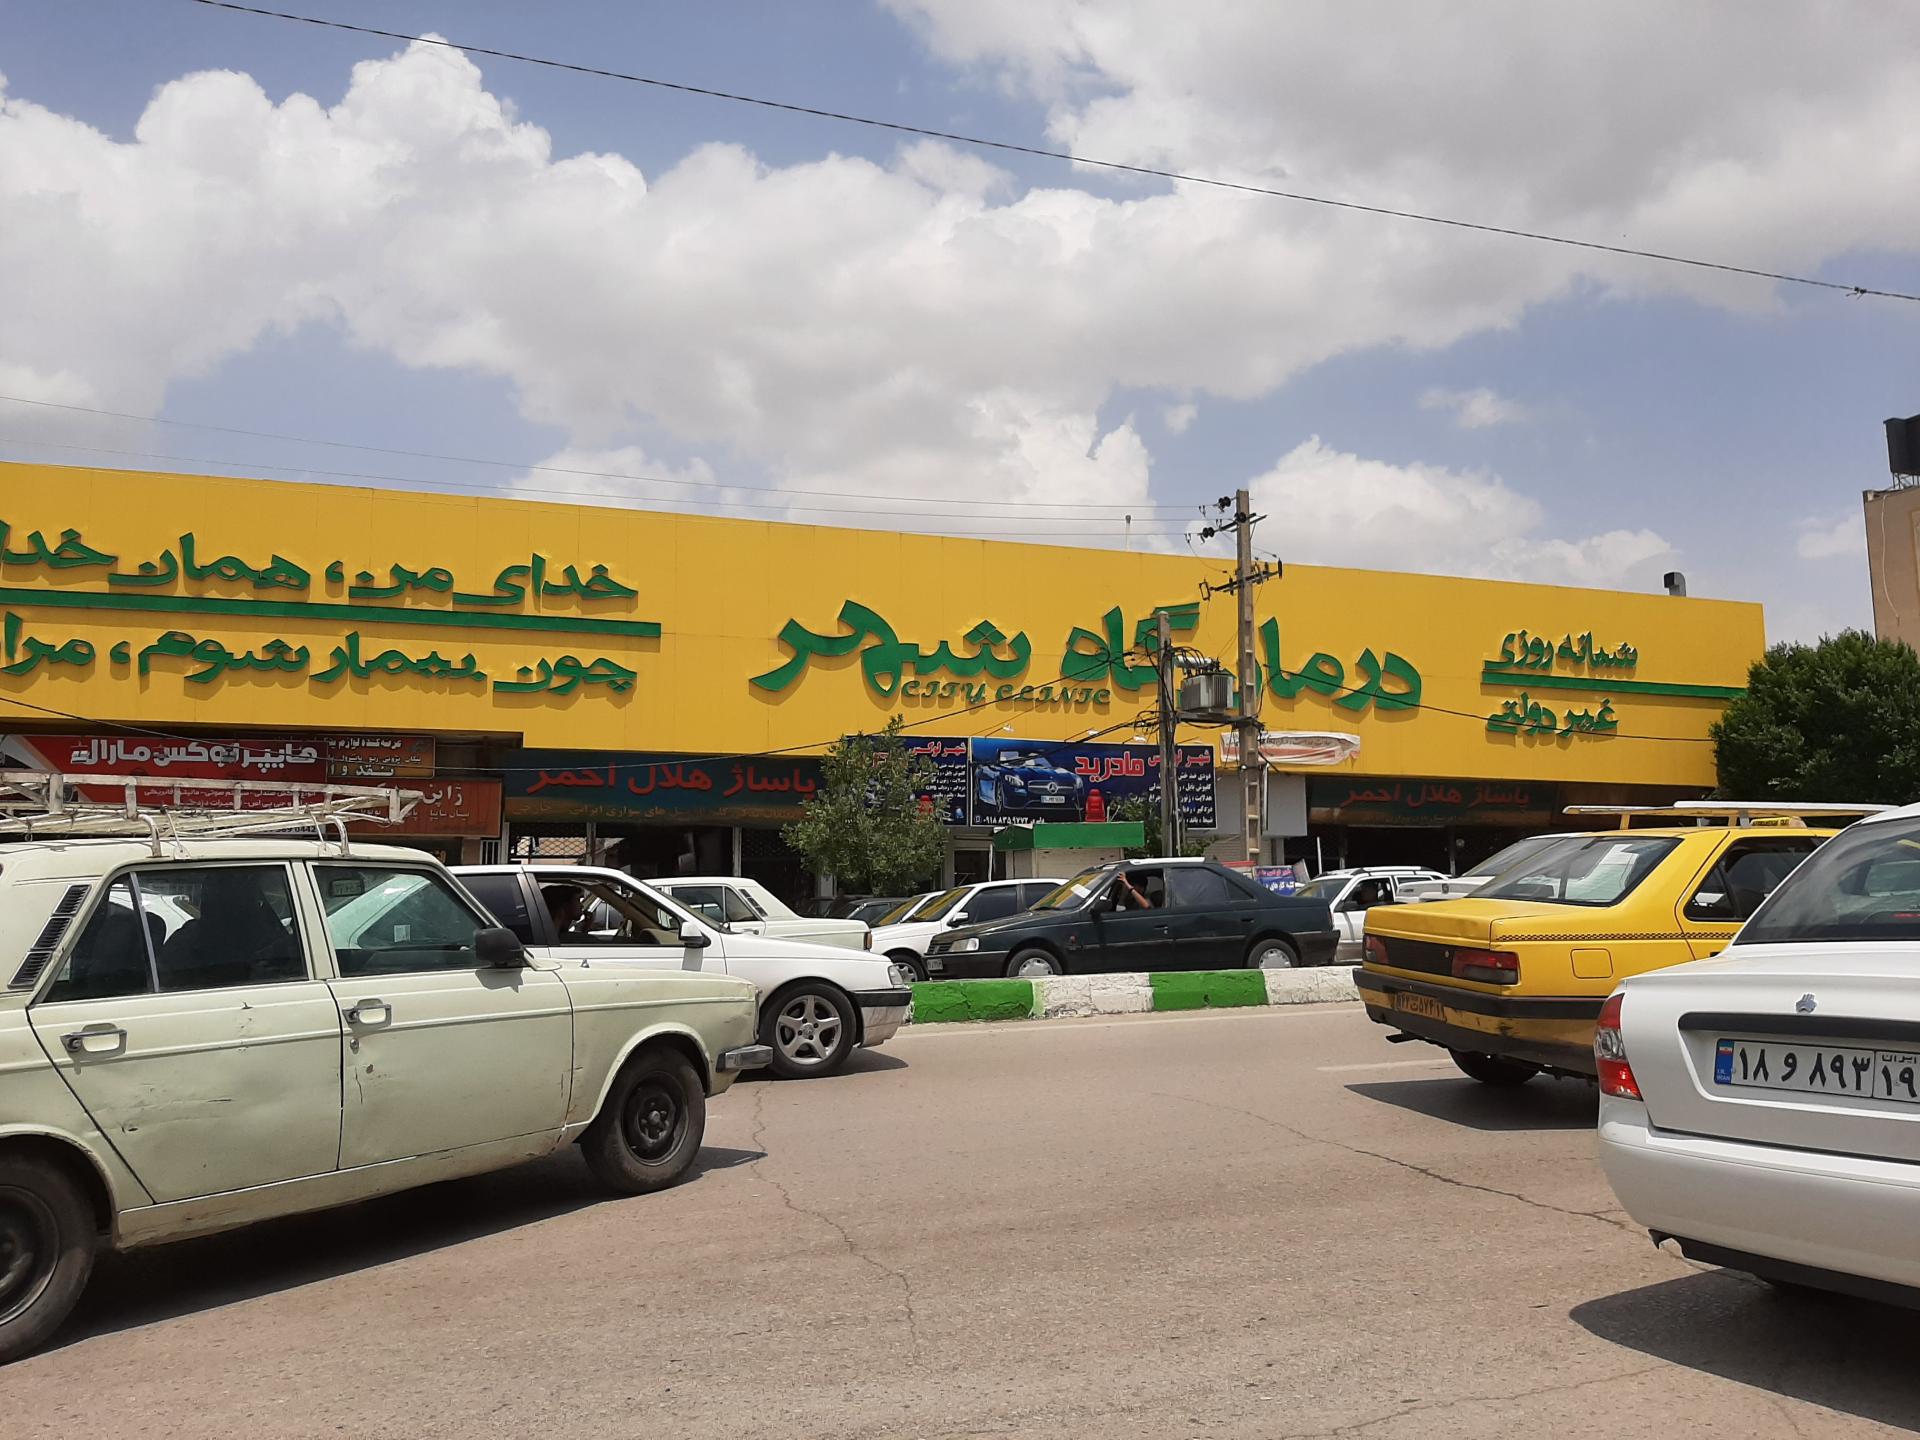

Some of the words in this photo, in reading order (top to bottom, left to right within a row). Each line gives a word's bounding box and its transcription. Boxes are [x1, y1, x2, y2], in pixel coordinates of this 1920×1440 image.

[107, 532, 311, 591] همان
[452, 552, 639, 605] خدای
[1, 610, 97, 677] مرا
[308, 630, 488, 683] بیمار
[748, 599, 1032, 698] شهر
[1059, 601, 1423, 710] درماگاه
[1484, 629, 1555, 671] روزی
[1555, 630, 1639, 669] شبانه
[492, 654, 638, 696] چون
[900, 679, 987, 704] CITY
[994, 684, 1111, 705] CLINIC
[1486, 691, 1557, 737] دولتی
[1555, 697, 1620, 738] غیر
[240, 742, 318, 774] هایپر
[356, 763, 396, 777] نقد
[1074, 750, 1146, 783] مادرید
[1147, 747, 1183, 767] لوس
[1184, 749, 1212, 768] شهر
[422, 783, 463, 807] ژاپن
[526, 761, 616, 794] احمر
[627, 762, 714, 795] هلال
[723, 763, 816, 800] پاساژ
[1339, 783, 1400, 810] احمر
[1407, 784, 1463, 809] هلال
[1881, 1053, 1918, 1065] ایران
[1881, 1064, 1918, 1099] ۱۹
